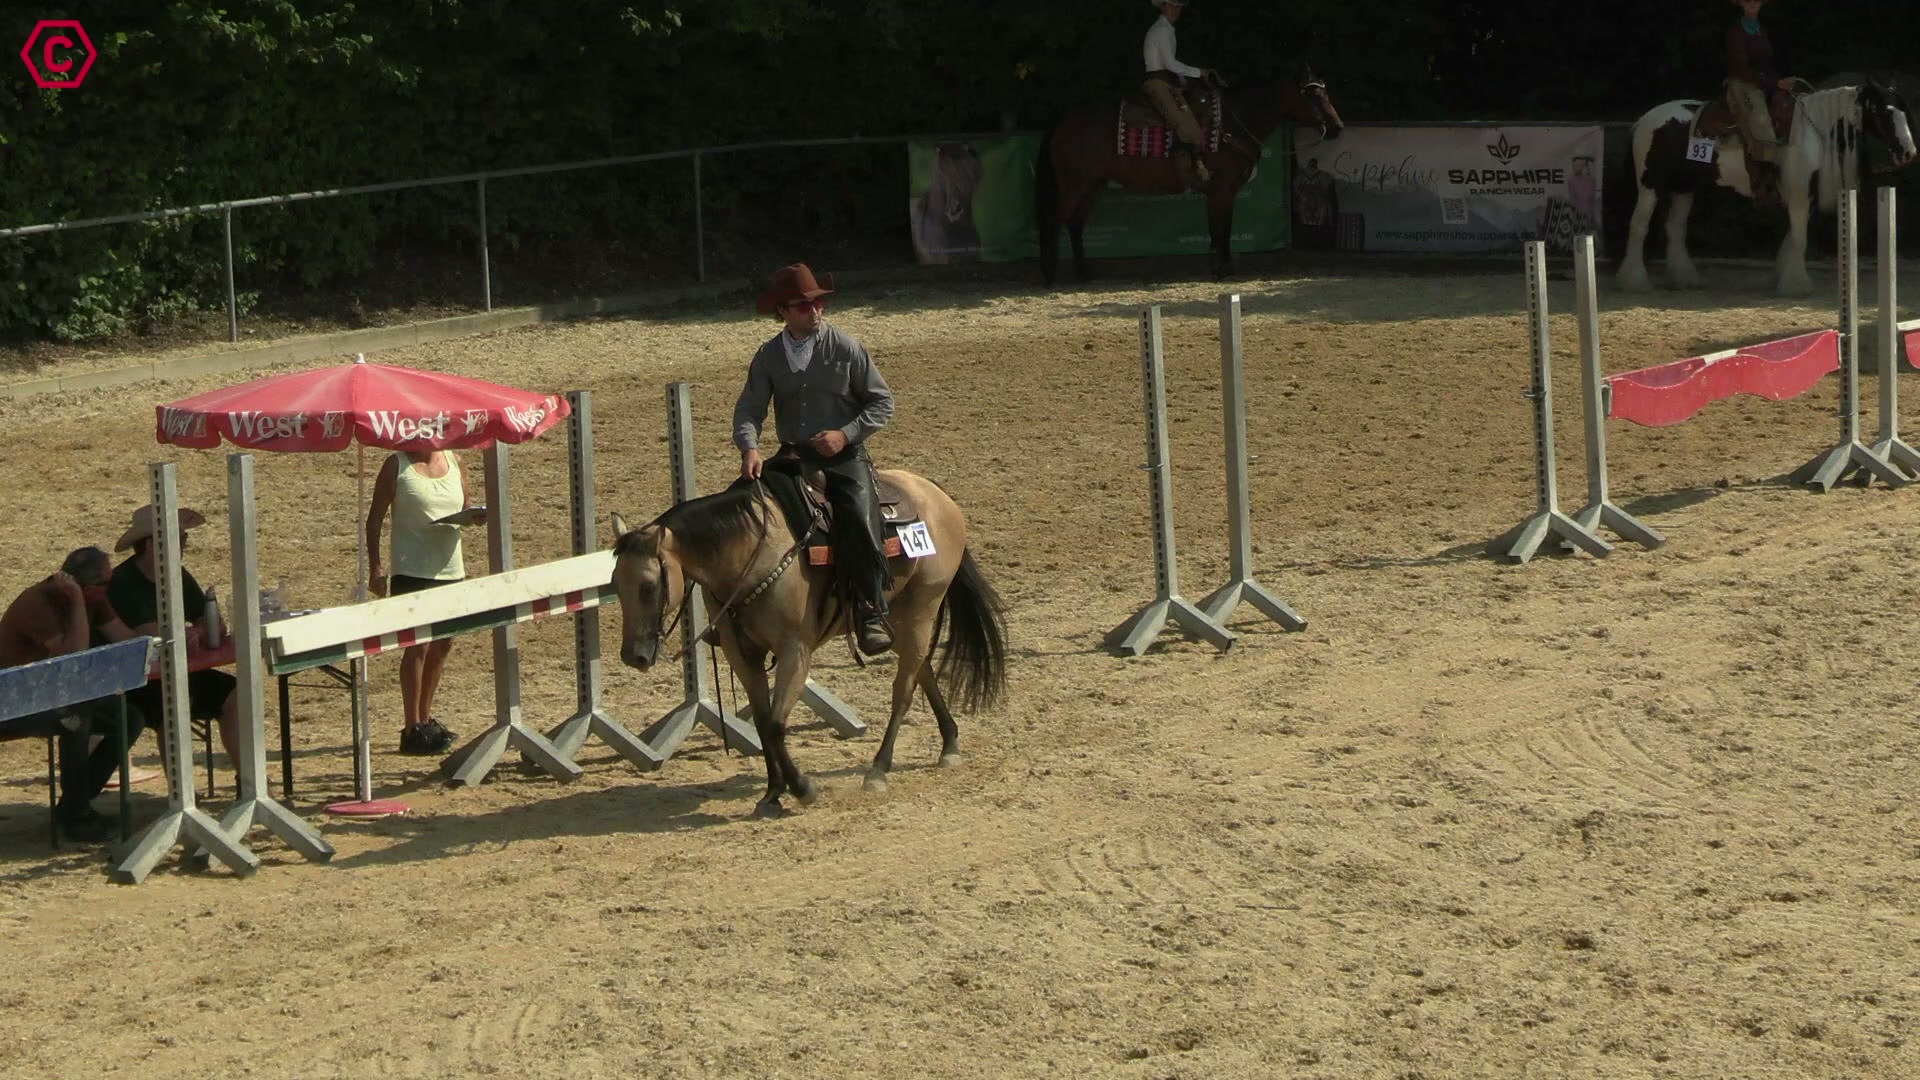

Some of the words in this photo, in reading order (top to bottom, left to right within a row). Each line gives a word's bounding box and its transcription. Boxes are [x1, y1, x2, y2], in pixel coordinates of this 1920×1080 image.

[1692, 144, 1707, 159] 93
[1447, 168, 1565, 185] SAPPHIRE
[228, 411, 306, 441] West
[366, 410, 450, 441] West
[902, 529, 929, 552] 147
